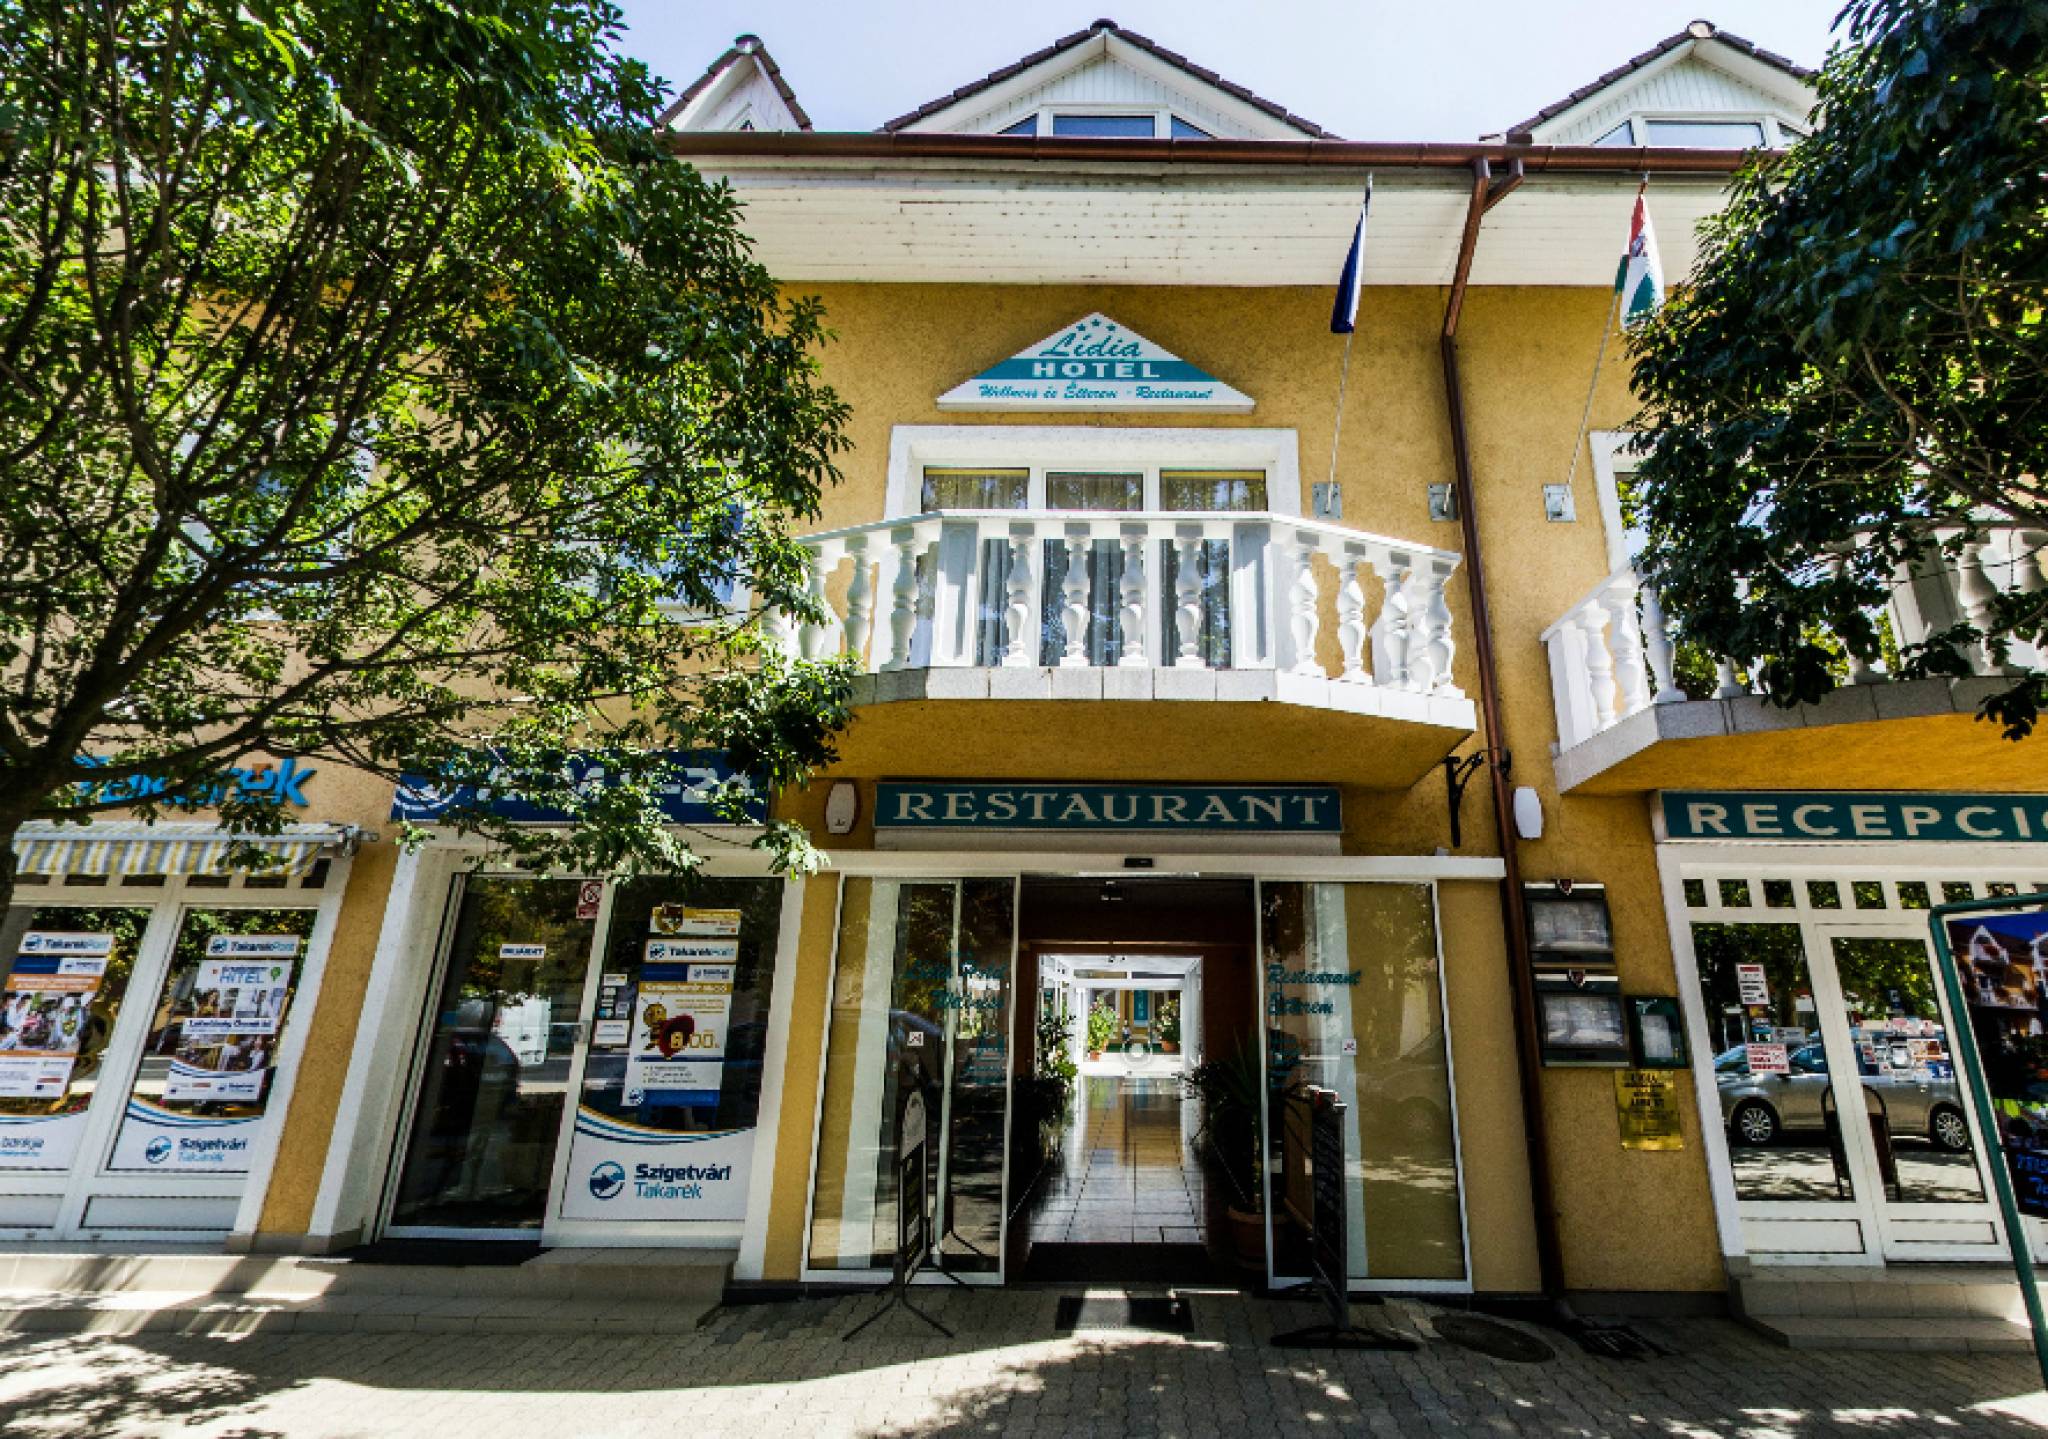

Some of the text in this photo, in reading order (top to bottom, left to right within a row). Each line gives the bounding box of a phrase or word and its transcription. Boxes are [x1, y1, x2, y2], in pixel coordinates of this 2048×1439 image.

[1032, 362, 1160, 378] HOTEL
[1135, 385, 1214, 398] Restaurant
[892, 791, 1329, 824] RESTAURANT
[1686, 802, 2048, 839] RECEPCI
[633, 1162, 732, 1183] Szigetvári
[633, 1181, 702, 1200] Takarék
